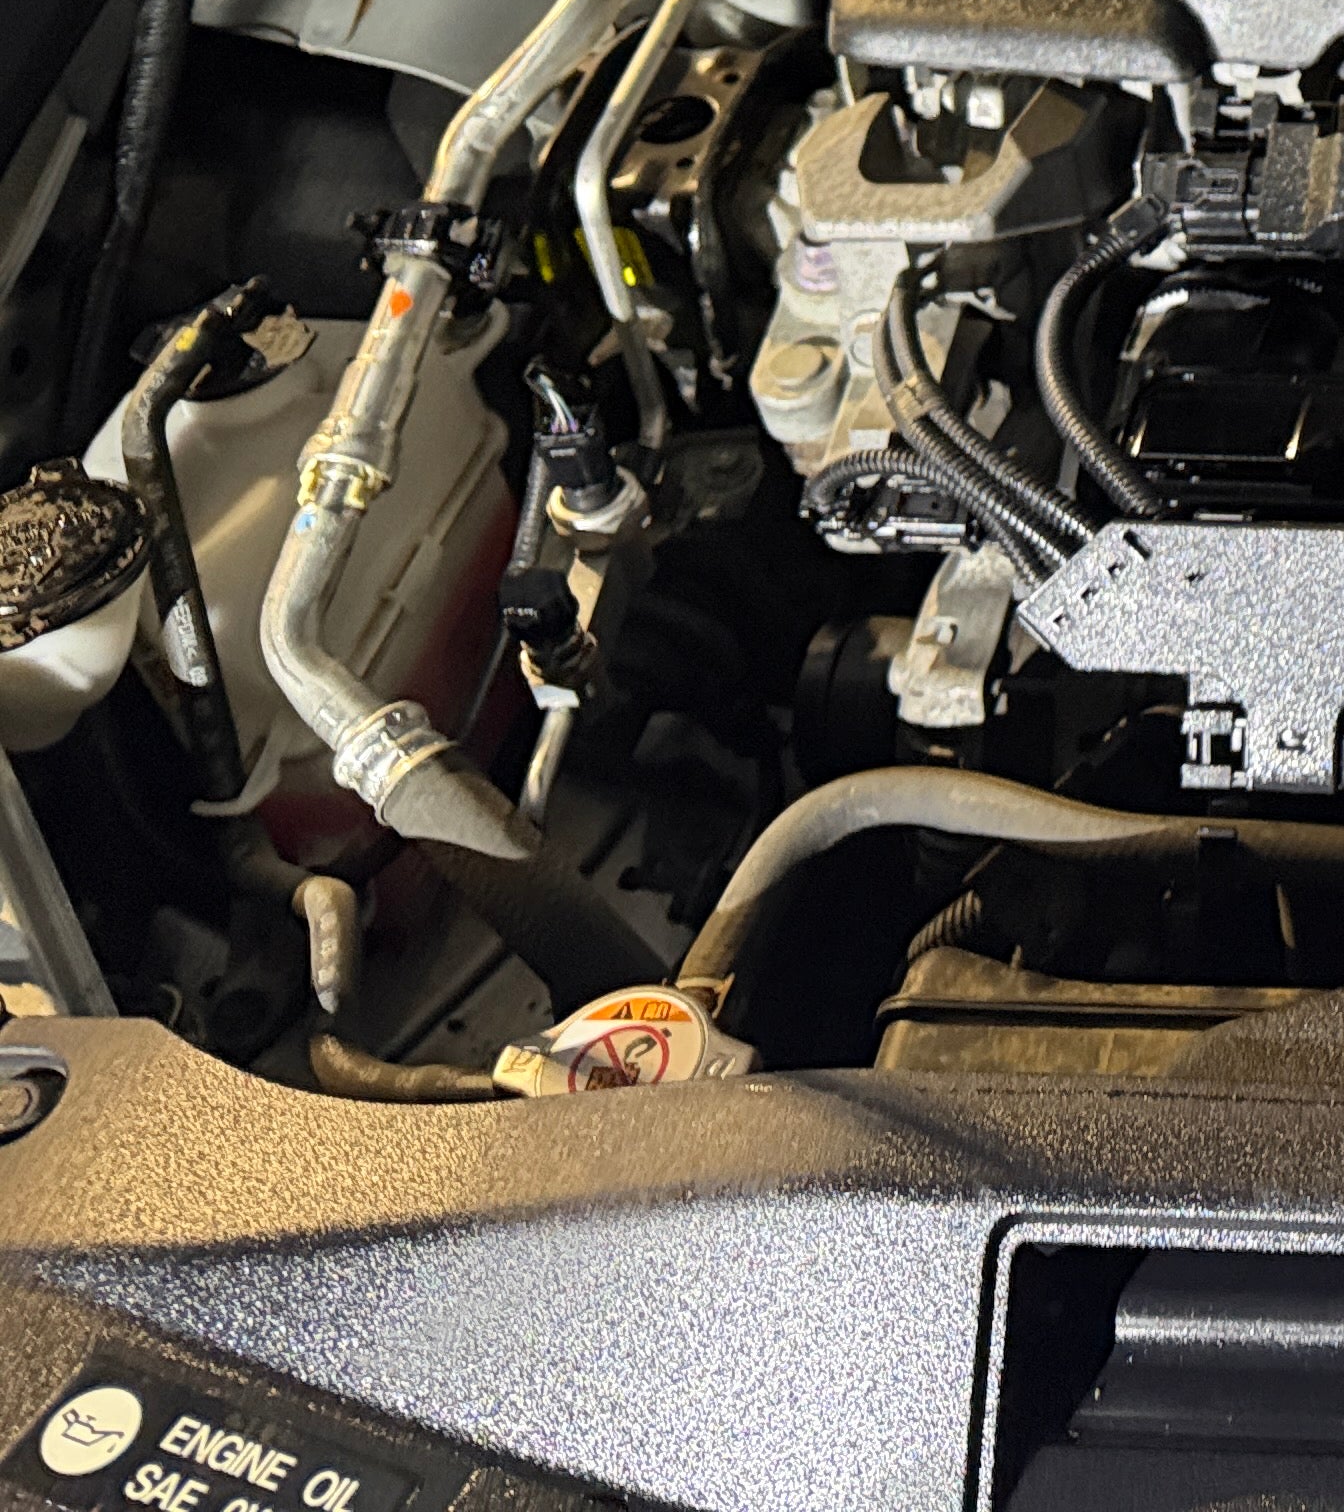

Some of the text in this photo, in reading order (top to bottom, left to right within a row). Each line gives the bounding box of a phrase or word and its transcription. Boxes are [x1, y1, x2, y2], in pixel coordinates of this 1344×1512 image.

[124, 1463, 211, 1512] SAE
[159, 1416, 361, 1512] ENGINE OIL
